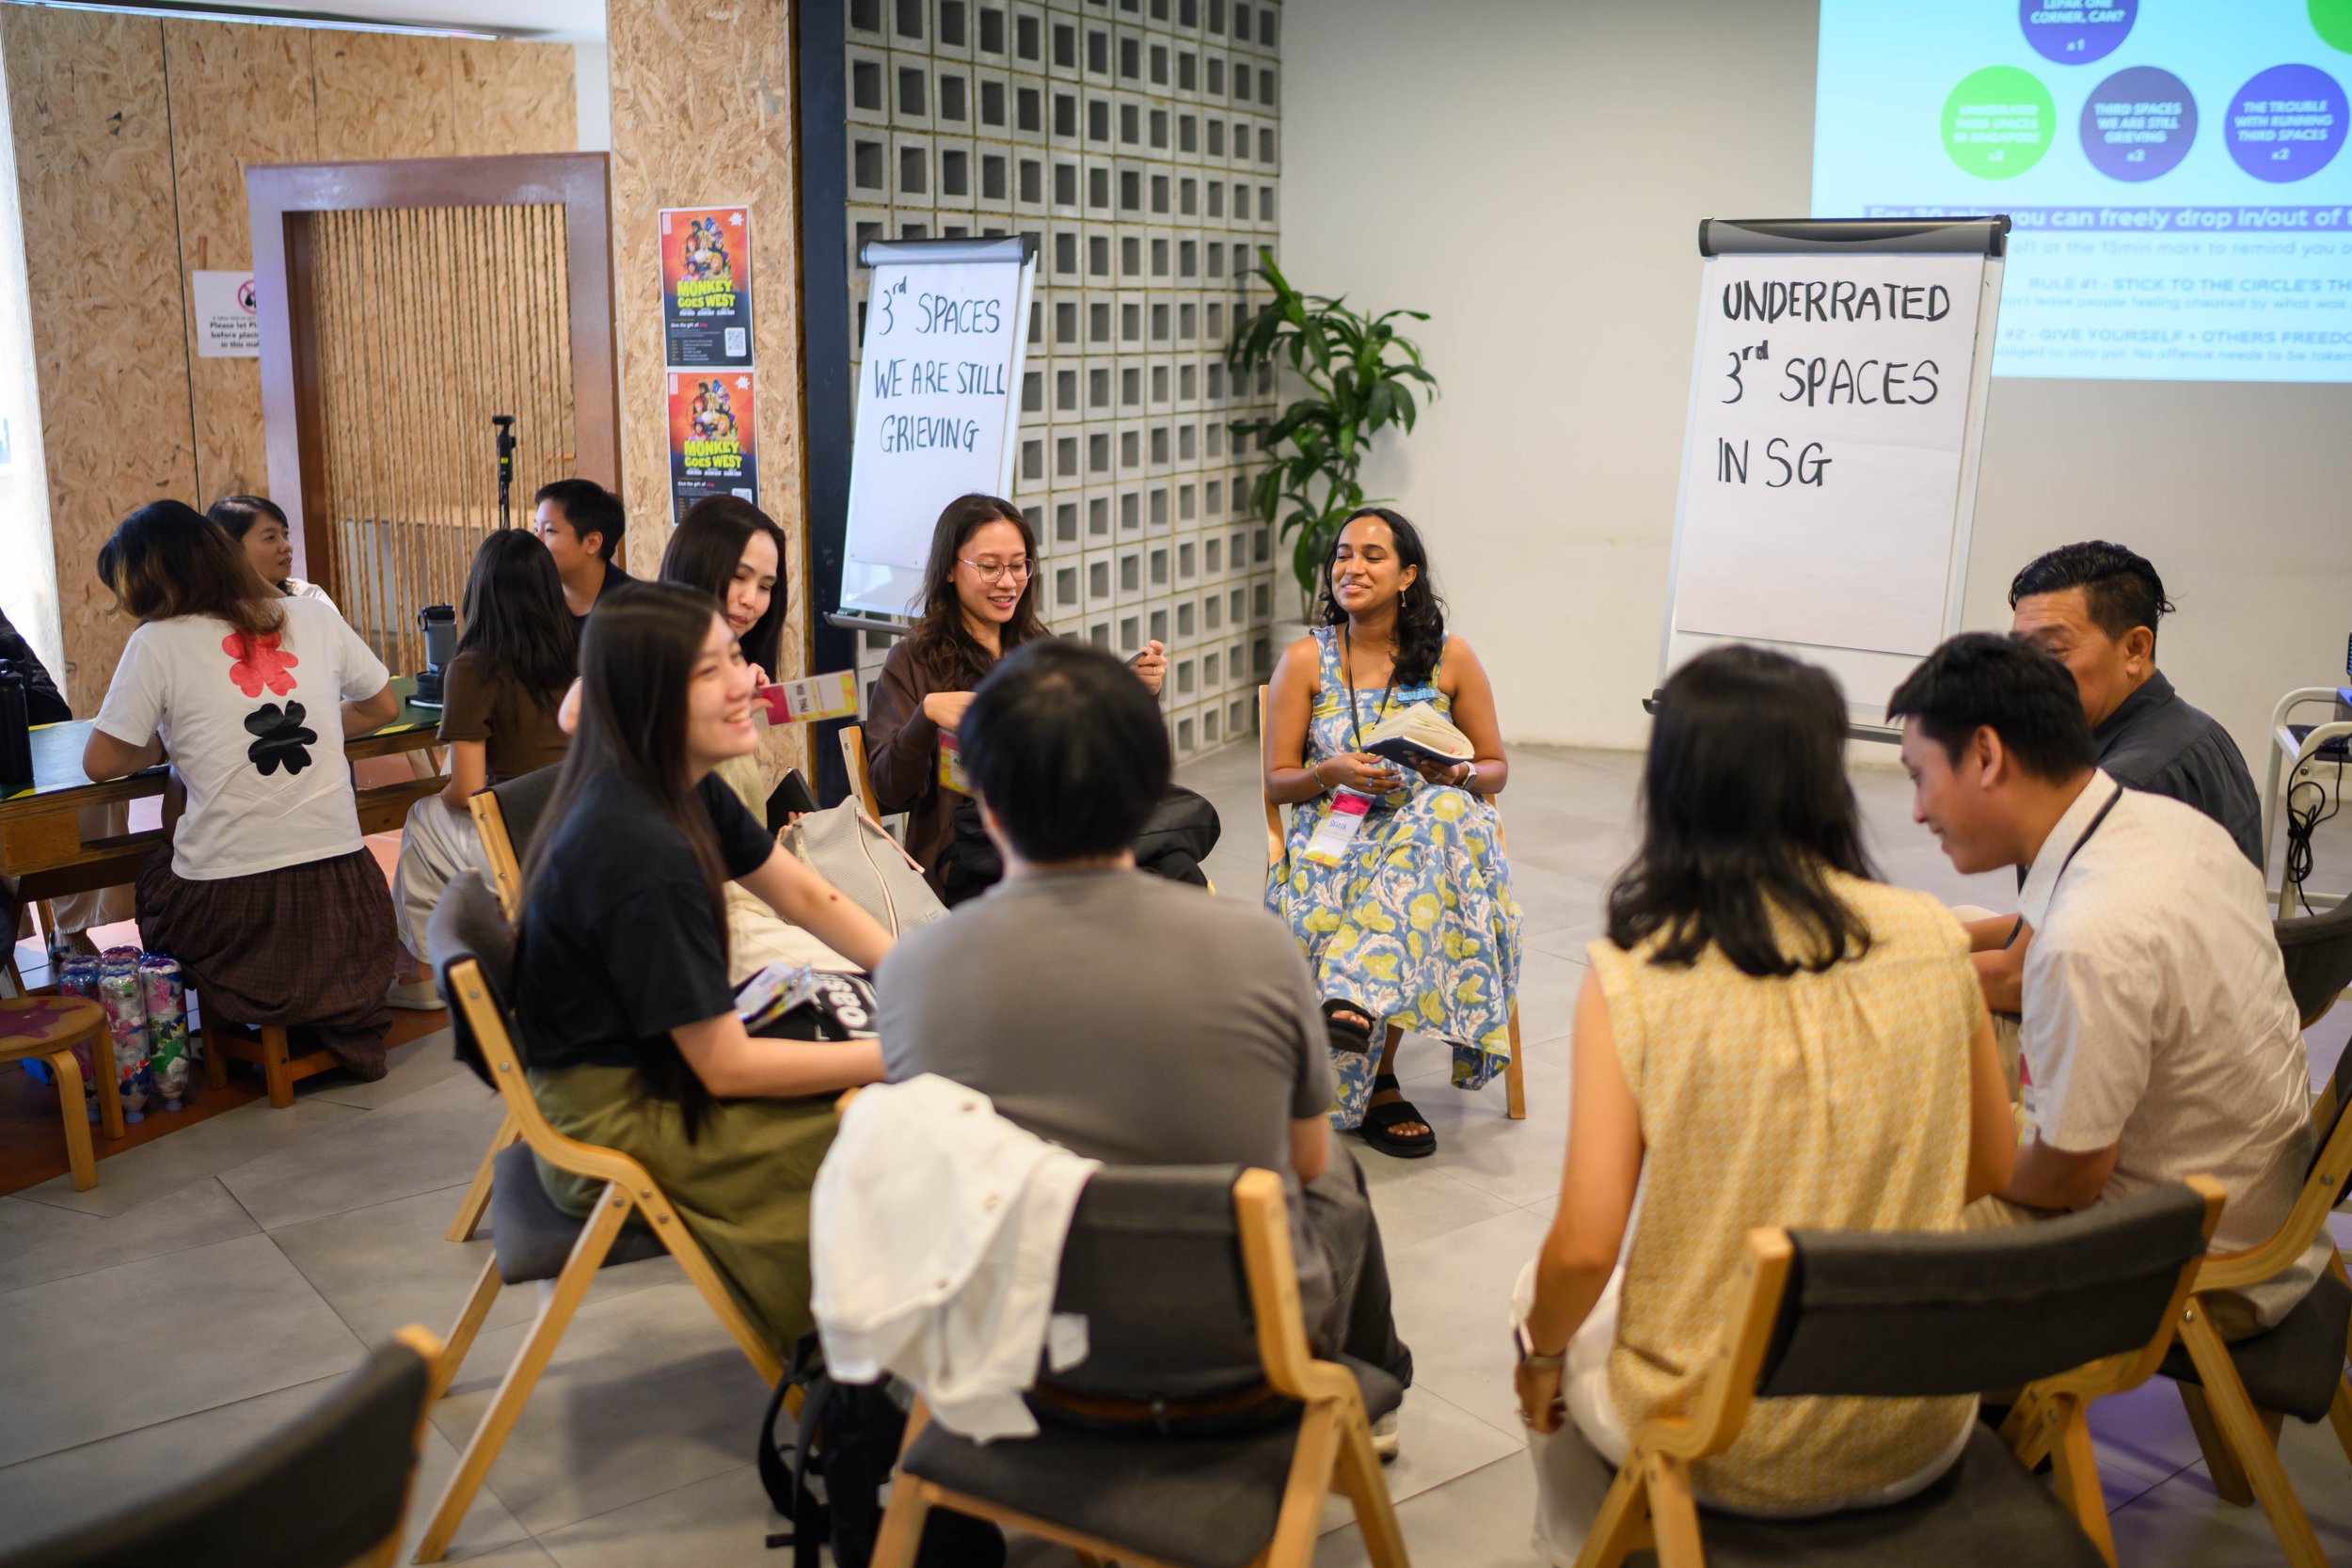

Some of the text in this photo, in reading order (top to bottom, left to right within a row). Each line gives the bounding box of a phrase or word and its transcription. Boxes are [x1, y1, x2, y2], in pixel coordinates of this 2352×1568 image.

[2133, 102, 2183, 116] SPACES
[2243, 100, 2328, 114] THE TROUBLE
[2120, 117, 2146, 130] ARE
[2146, 116, 2180, 130] STILL
[2234, 114, 2334, 128] WITH RUNNING
[2237, 128, 2328, 142] THIRD SPACES
[2051, 211, 2096, 227] can
[2099, 208, 2169, 231] freely
[2174, 208, 2233, 230] drop
[2237, 207, 2309, 228] in/out
[2314, 206, 2344, 227] of
[2042, 241, 2060, 254] at
[2066, 240, 2094, 254] the
[2156, 240, 2200, 255] mark
[2208, 242, 2227, 255] to
[2232, 240, 2296, 255] remind
[2302, 244, 2335, 258] you
[677, 279, 733, 297] MONKEY
[2112, 277, 2165, 292] STICK
[2171, 277, 2195, 292] TO
[2199, 277, 2233, 292] THE
[2239, 277, 2322, 293] CIRCLE'S
[677, 293, 736, 309] GOES WEST
[1723, 280, 1950, 324] UNDERRATED
[2273, 298, 2311, 309] what
[2315, 300, 2347, 309] was
[915, 293, 1000, 335] SPACES
[2039, 328, 2082, 341] GIVE
[2088, 328, 2184, 343] YOURSELF
[2201, 330, 2276, 344] OTHERS
[2267, 350, 2282, 361] to
[875, 358, 1006, 399] WE ARE STILL
[1779, 357, 1939, 407] SPACES
[881, 414, 979, 453] GRIEVING
[683, 439, 739, 457] MONKEY
[684, 454, 742, 468] GOES WEST
[1718, 436, 1832, 487] IN SG
